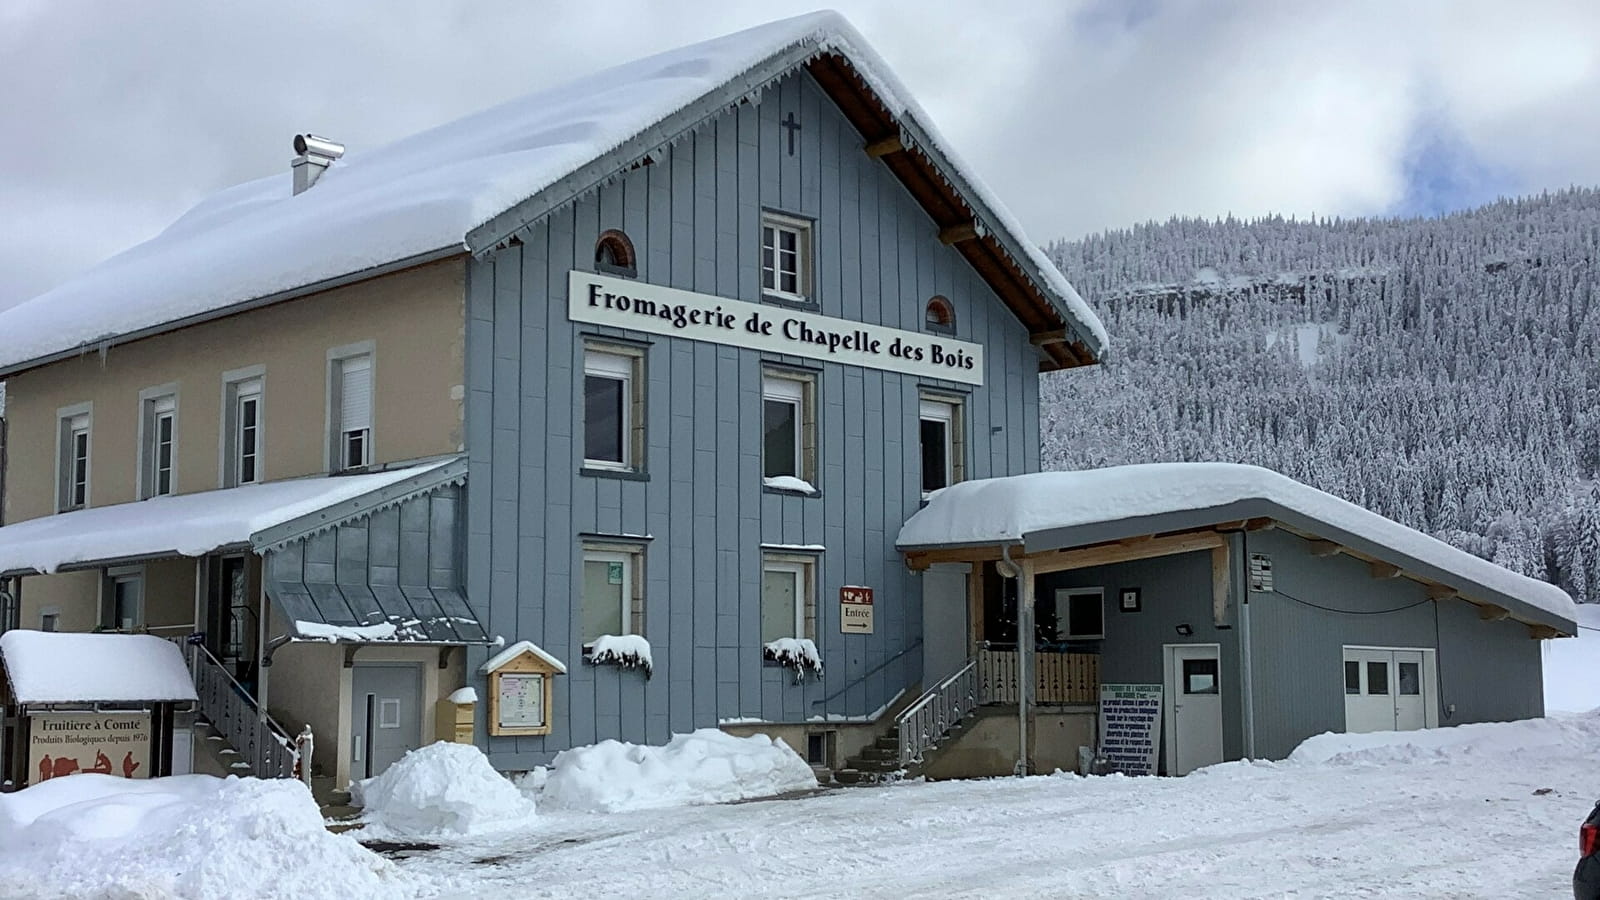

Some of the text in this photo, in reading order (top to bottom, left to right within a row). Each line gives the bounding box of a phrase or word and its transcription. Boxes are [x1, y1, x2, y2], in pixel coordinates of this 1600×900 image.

[587, 283, 974, 371] Fromagerie de Chapelle des Bois
[845, 606, 870, 618] Entrée
[43, 718, 141, 731] Fruitière à Comté
[32, 735, 63, 744] Produits
[65, 734, 106, 746] Biologiques
[107, 734, 130, 745] depuis
